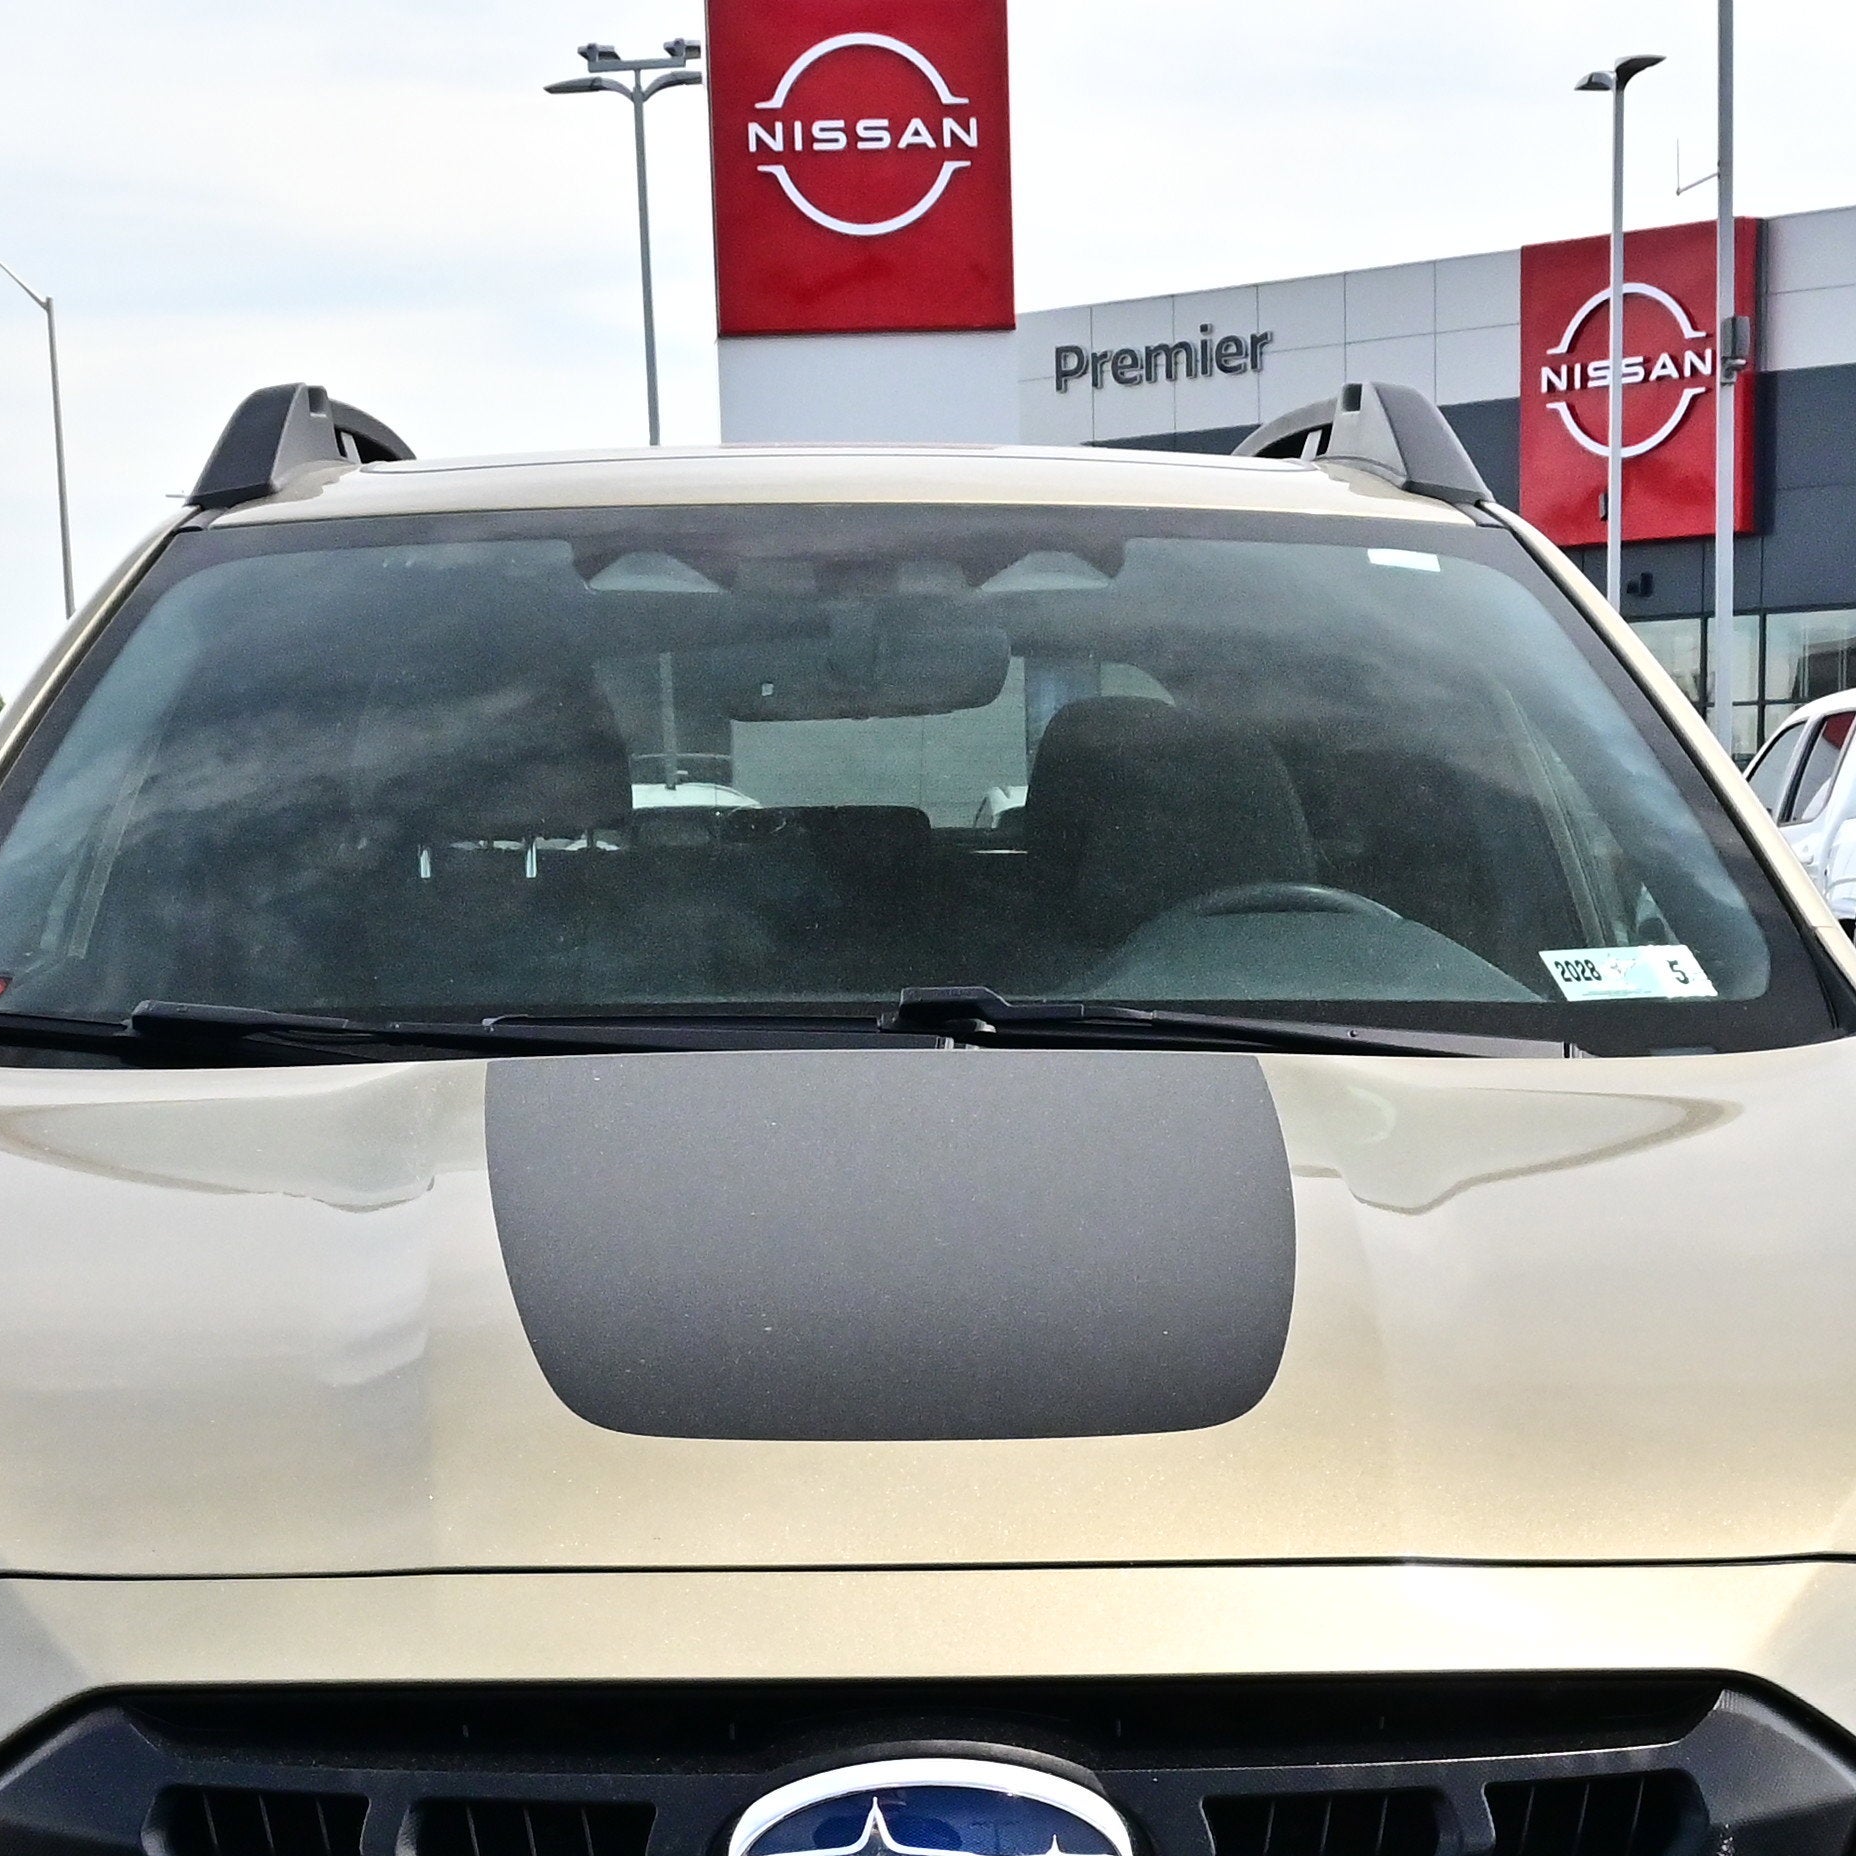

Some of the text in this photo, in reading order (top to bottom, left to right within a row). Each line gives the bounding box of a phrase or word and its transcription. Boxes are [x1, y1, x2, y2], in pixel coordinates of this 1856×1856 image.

[747, 117, 978, 153] NISSAN
[1055, 323, 1273, 394] Premier
[1541, 348, 1712, 394] NISSAN
[1554, 959, 1690, 985] 2028 5
